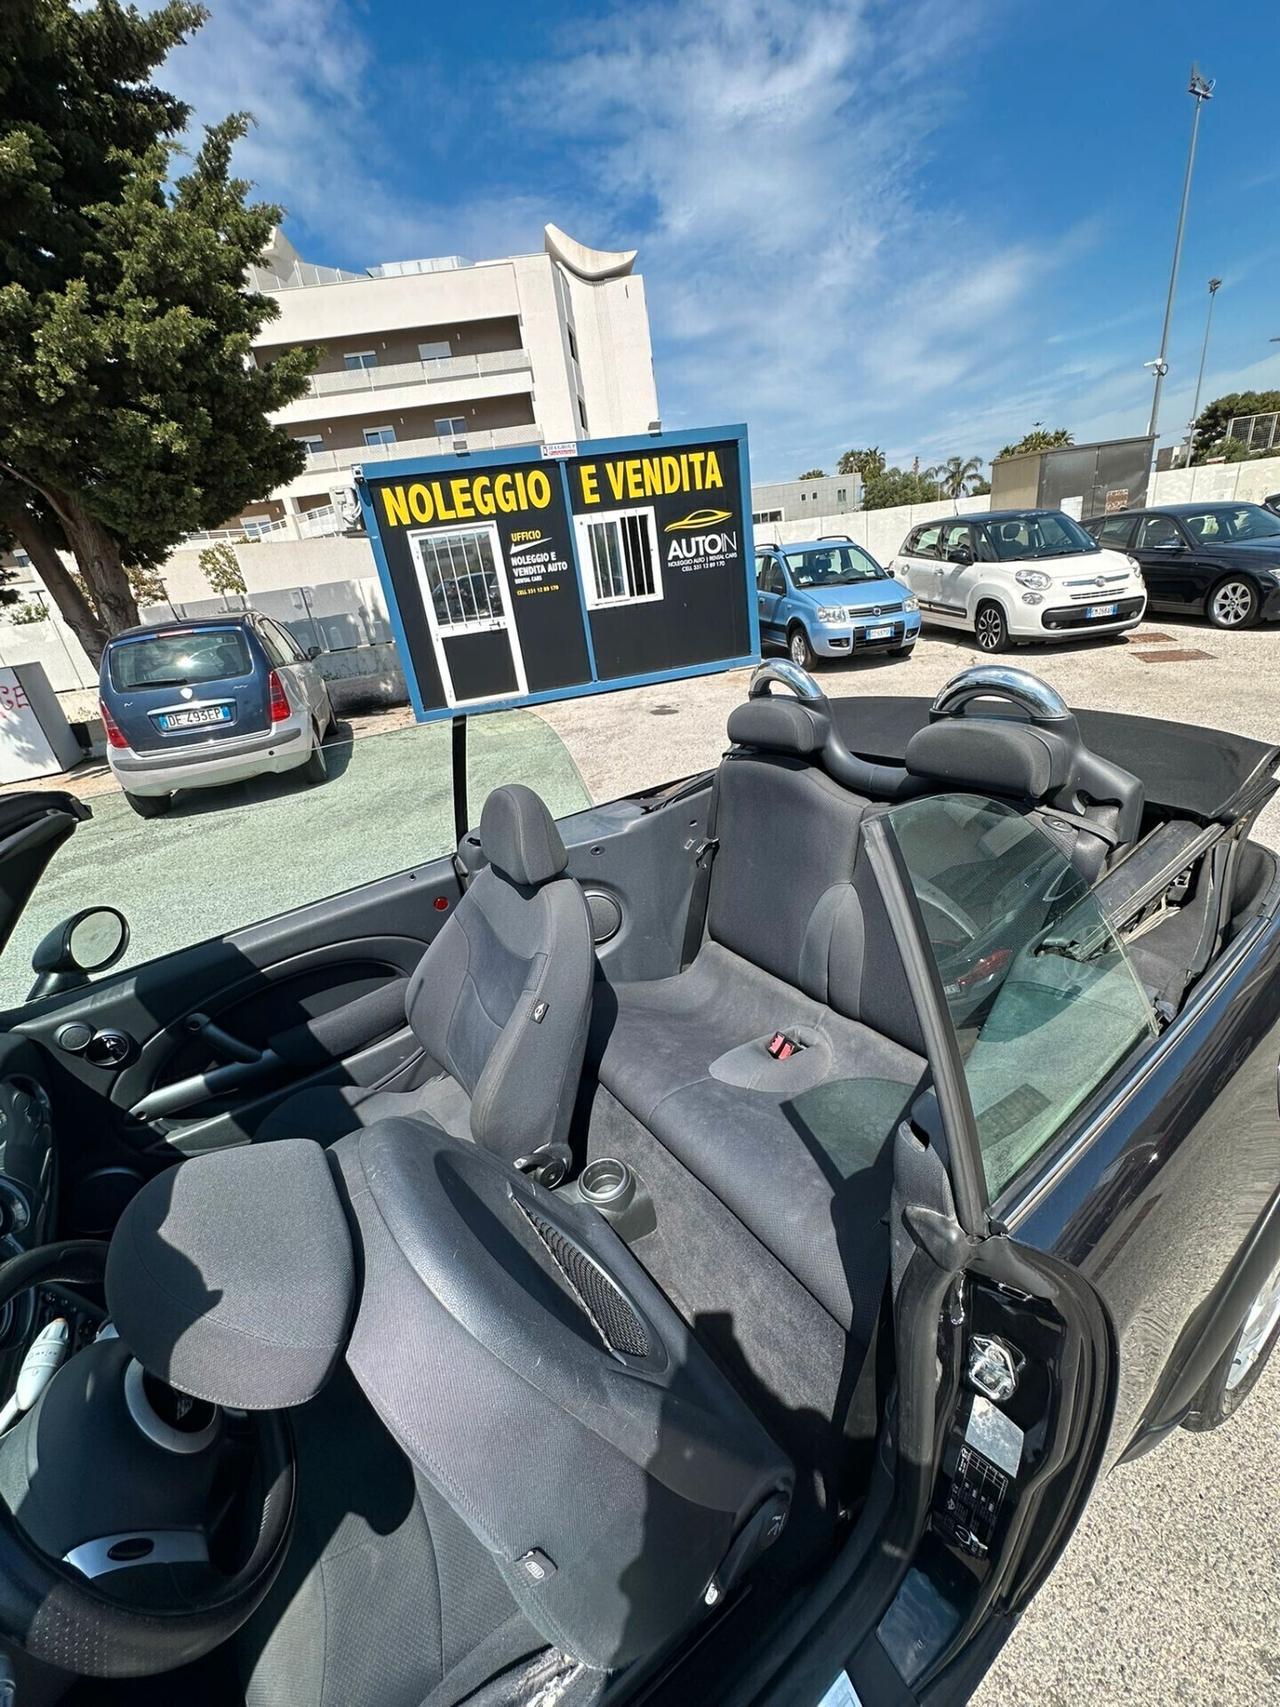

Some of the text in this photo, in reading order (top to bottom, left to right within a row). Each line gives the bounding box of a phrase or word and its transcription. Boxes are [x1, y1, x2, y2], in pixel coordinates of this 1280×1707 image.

[381, 451, 724, 527] NOLEGGIO E VENDITA
[511, 530, 542, 542] UFFICIO
[511, 551, 557, 567] NOLEGGIO E
[512, 561, 568, 577] VENDITA AUTO
[167, 708, 222, 728] DE 493EP
